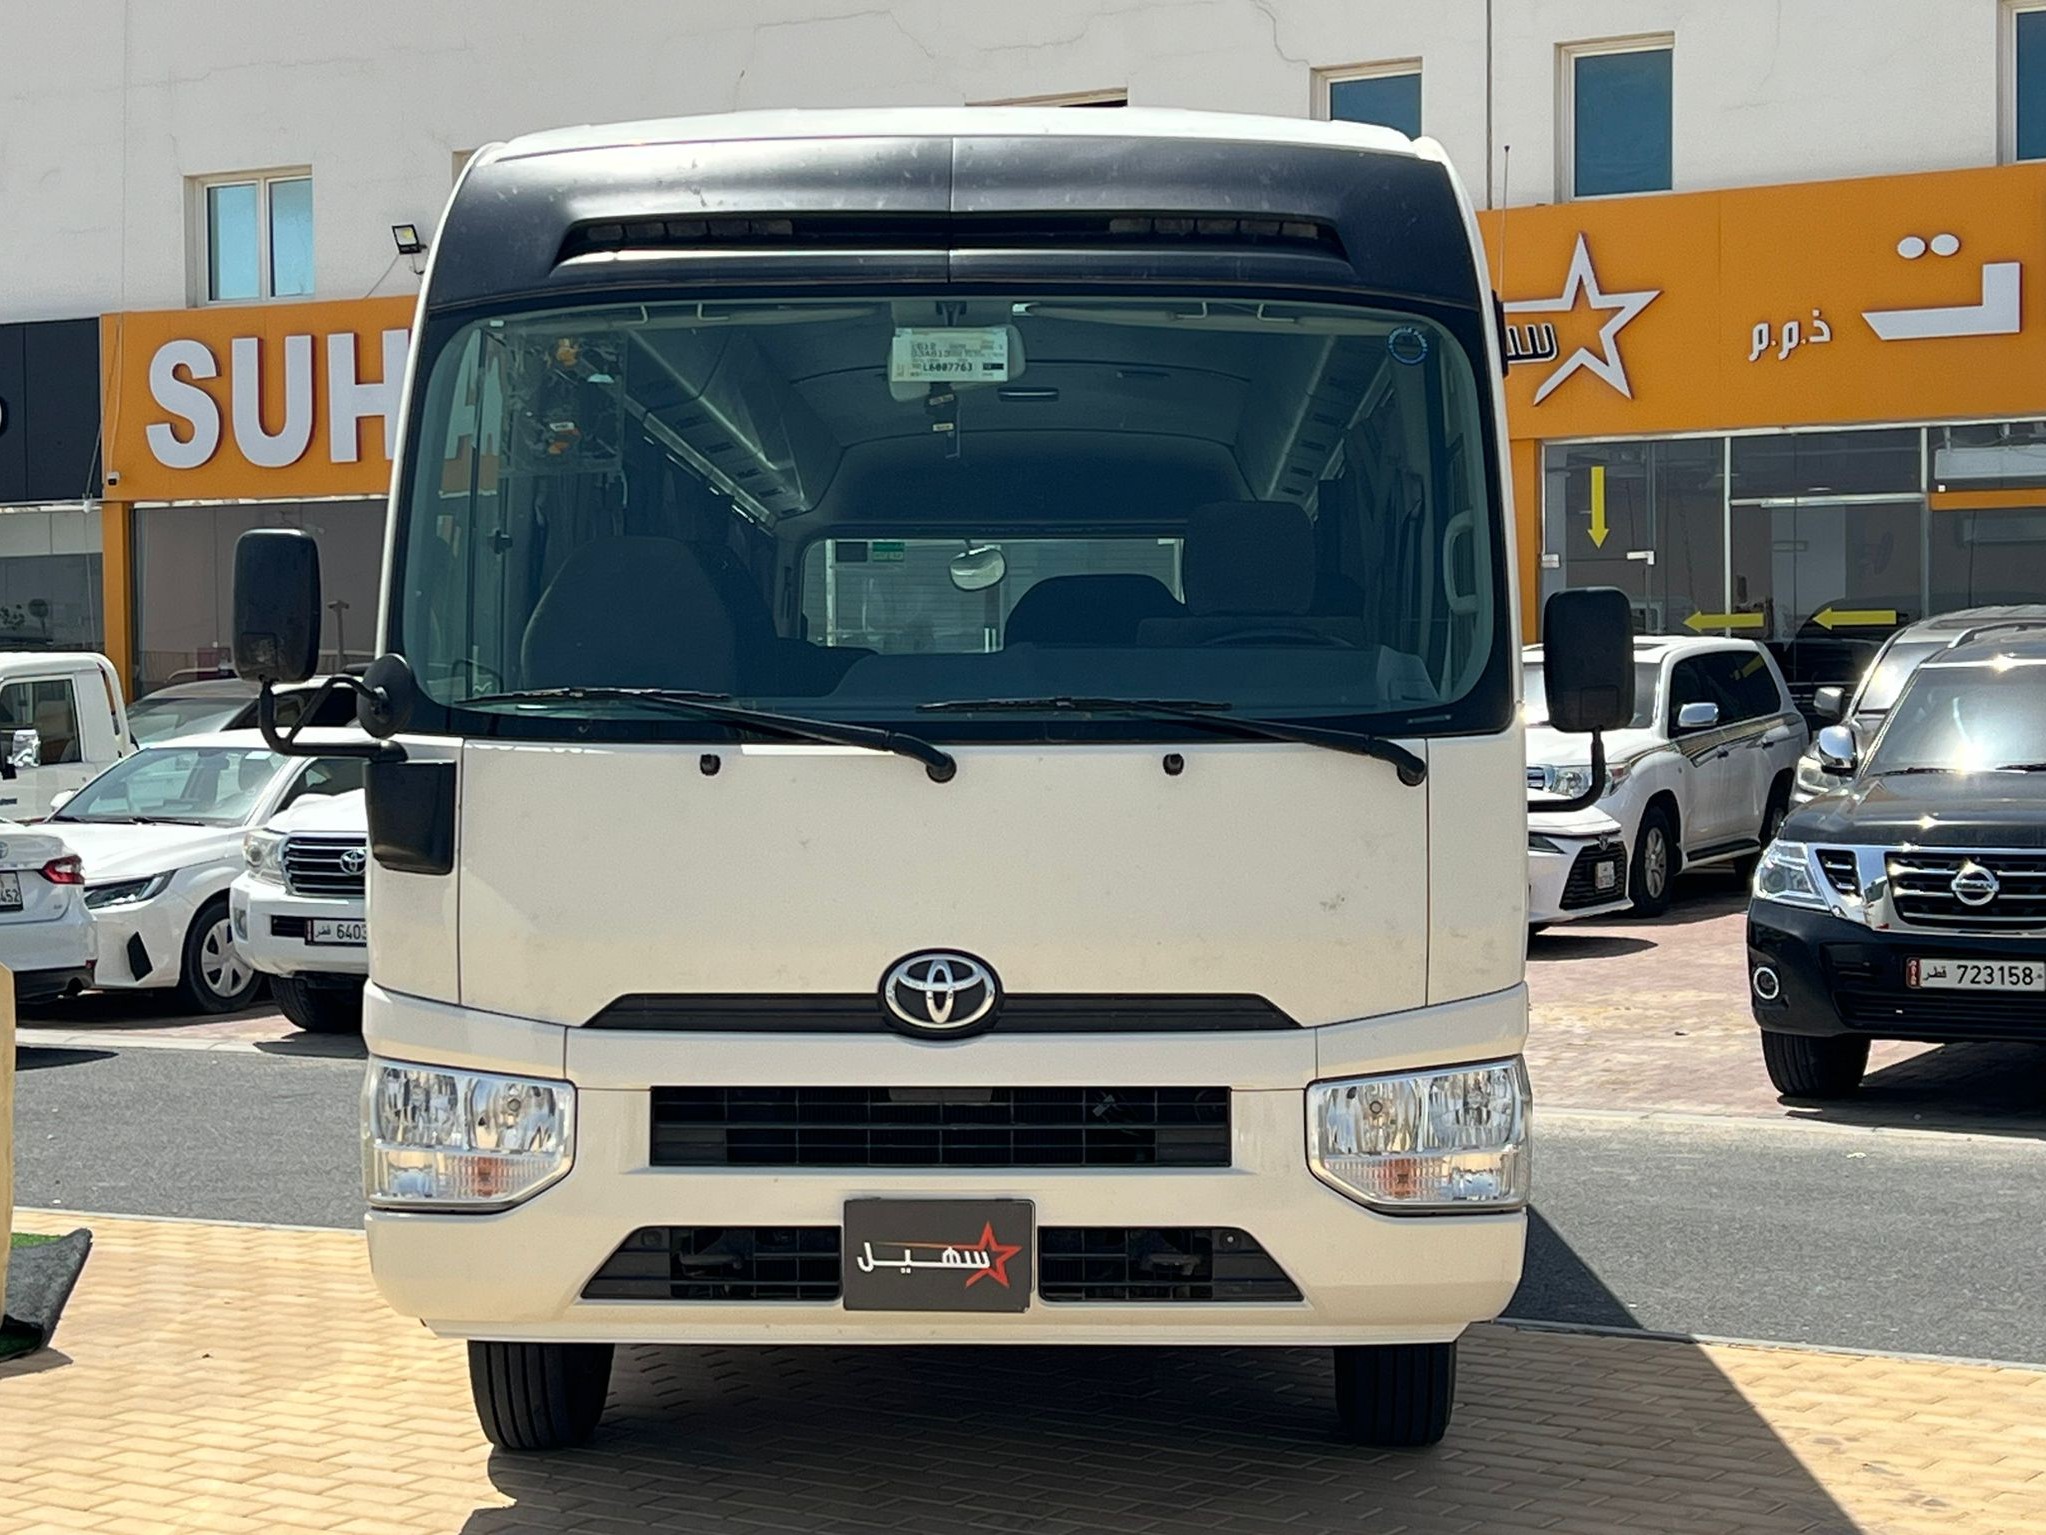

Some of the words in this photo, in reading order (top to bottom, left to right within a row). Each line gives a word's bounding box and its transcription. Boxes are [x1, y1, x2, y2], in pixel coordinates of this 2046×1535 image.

[146, 329, 409, 469] SUH
[1956, 964, 2034, 986] 723158
[856, 1241, 991, 1274] سهيل
